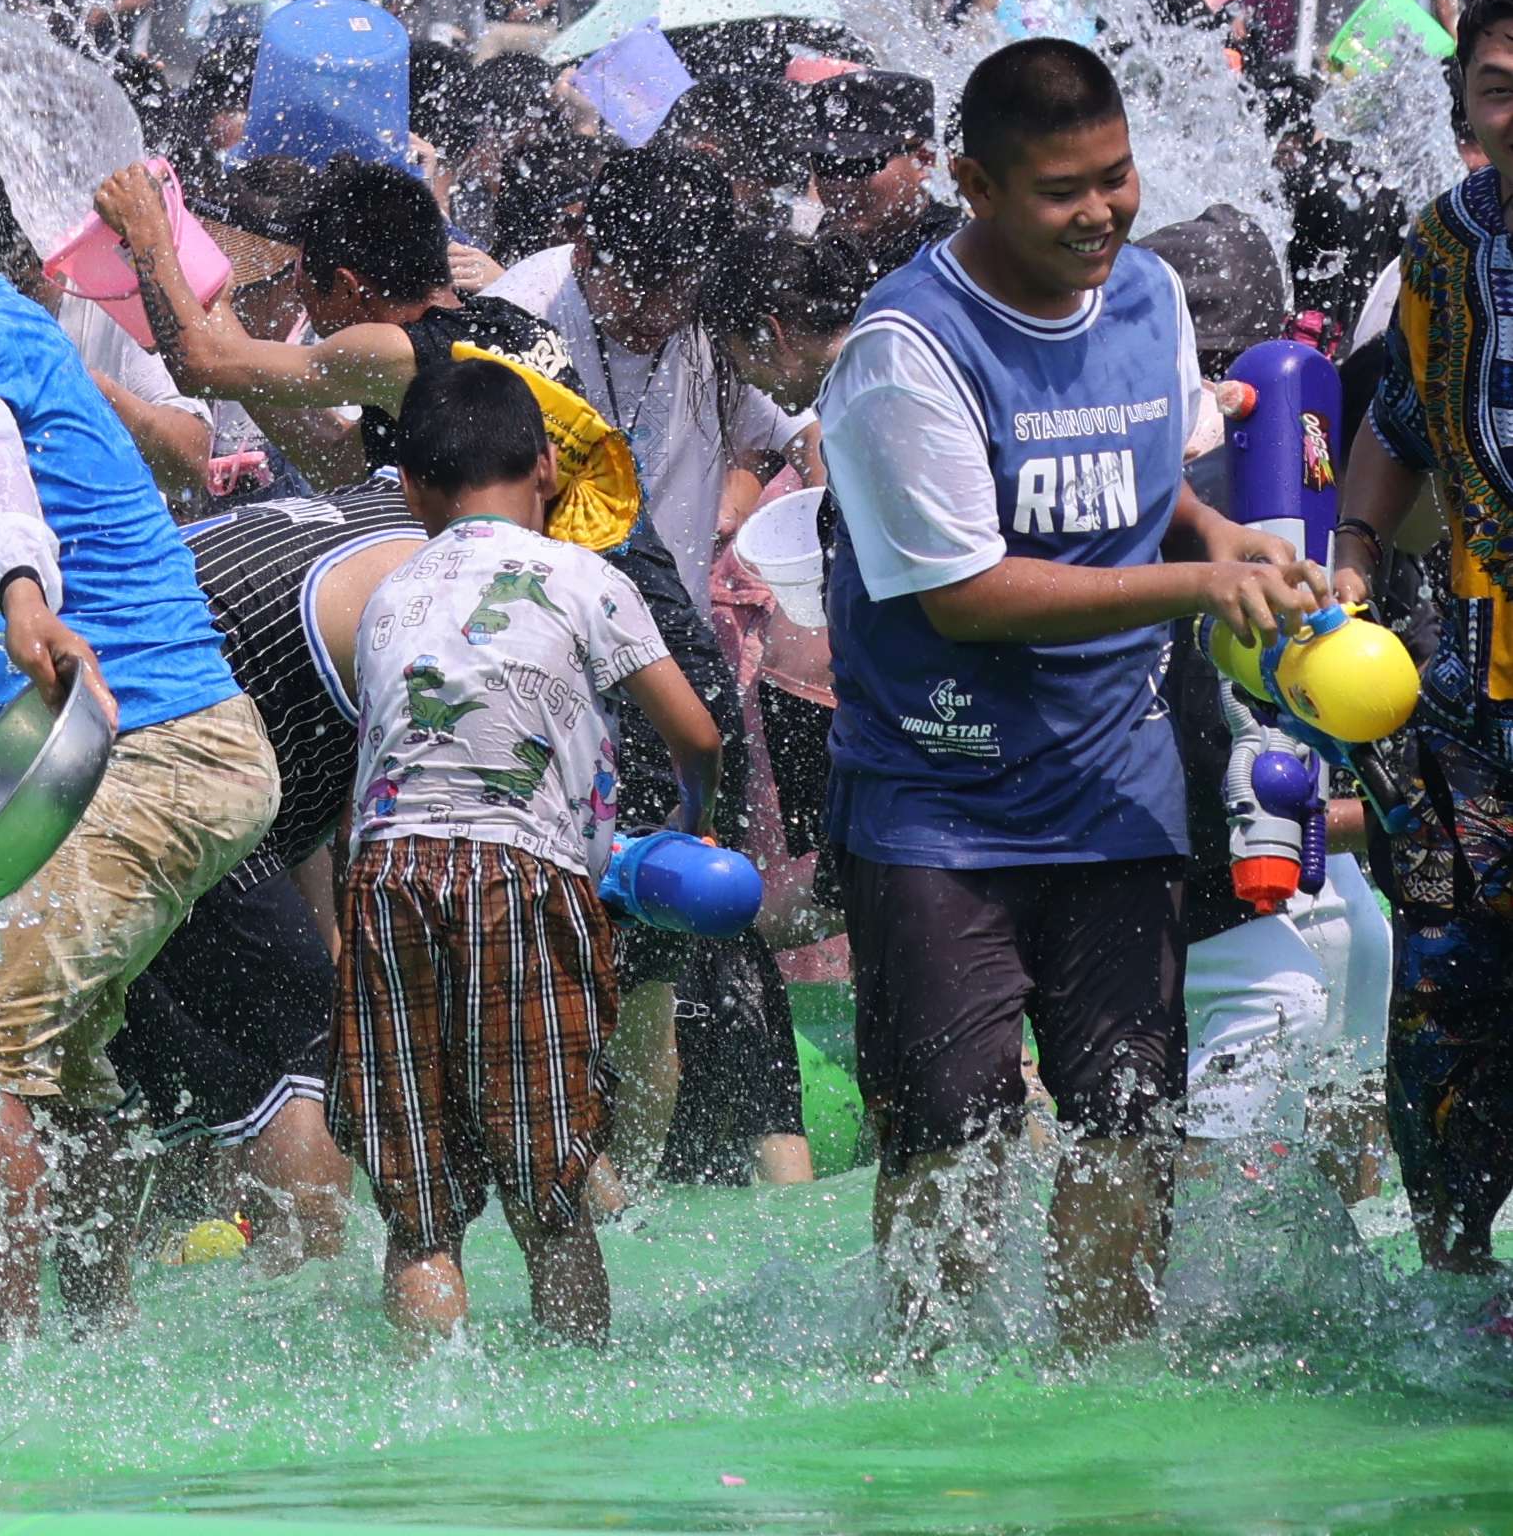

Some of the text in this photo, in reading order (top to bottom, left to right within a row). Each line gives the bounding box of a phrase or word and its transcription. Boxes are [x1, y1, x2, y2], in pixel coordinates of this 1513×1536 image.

[1013, 449, 1138, 534] RUN
[485, 658, 592, 730] JUST
[936, 689, 973, 707] Star
[946, 723, 993, 738] STAR
